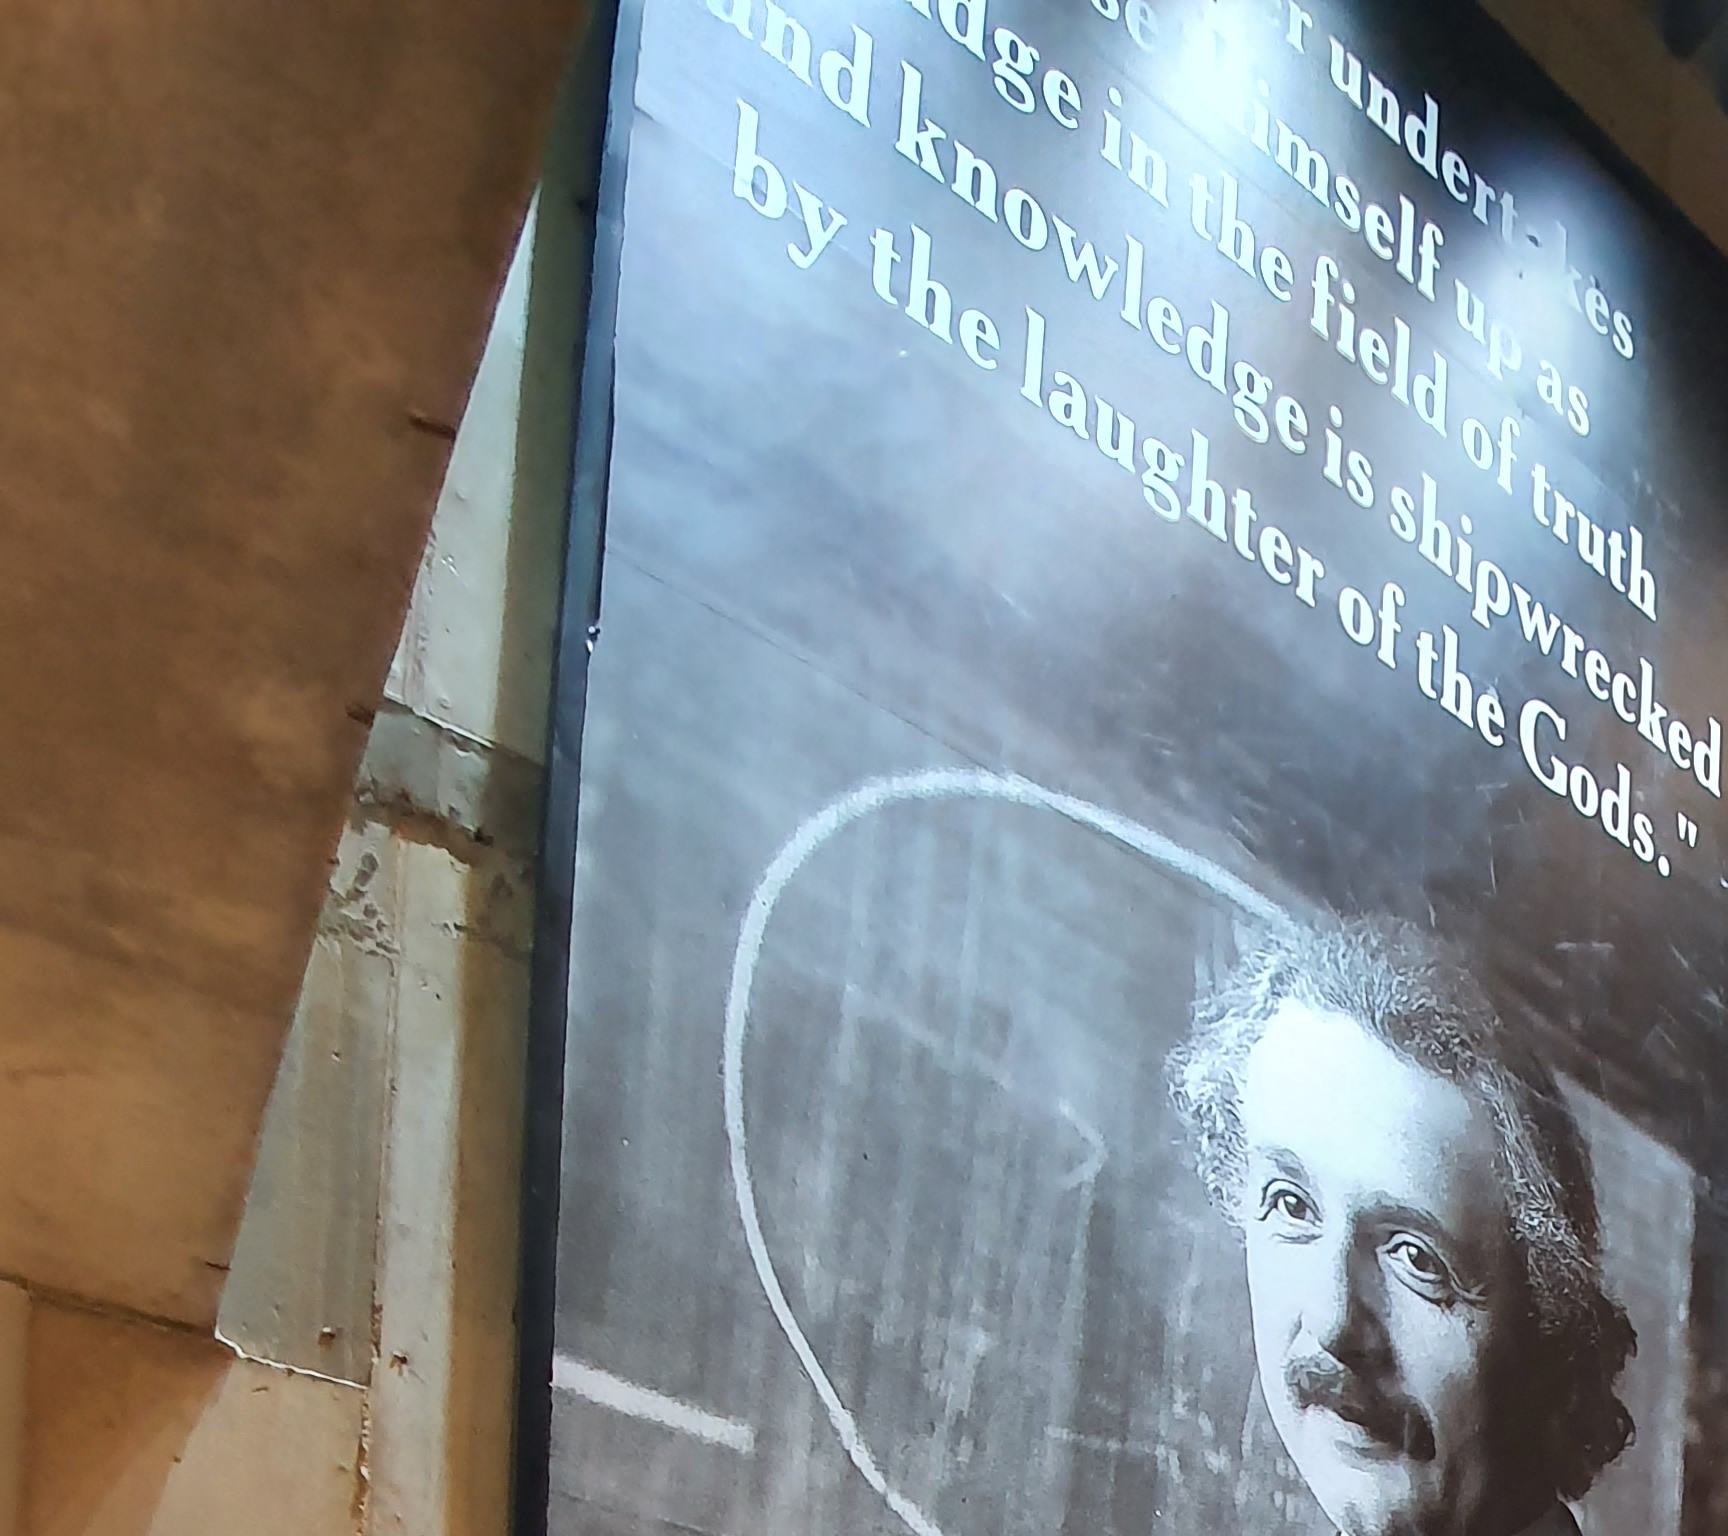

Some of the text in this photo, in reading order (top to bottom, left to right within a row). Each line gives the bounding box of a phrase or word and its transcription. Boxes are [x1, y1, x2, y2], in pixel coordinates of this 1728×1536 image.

[732, 97, 1697, 876] by the laughter of the Gods."
[895, 59, 1308, 455] knowledge
[1323, 405, 1375, 508] is
[1389, 472, 1723, 799] shipwrecked
[906, 0, 1656, 622] dge in the field of truth
[1207, 28, 1591, 437] imself up as
[1329, 33, 1634, 360] undertkes
